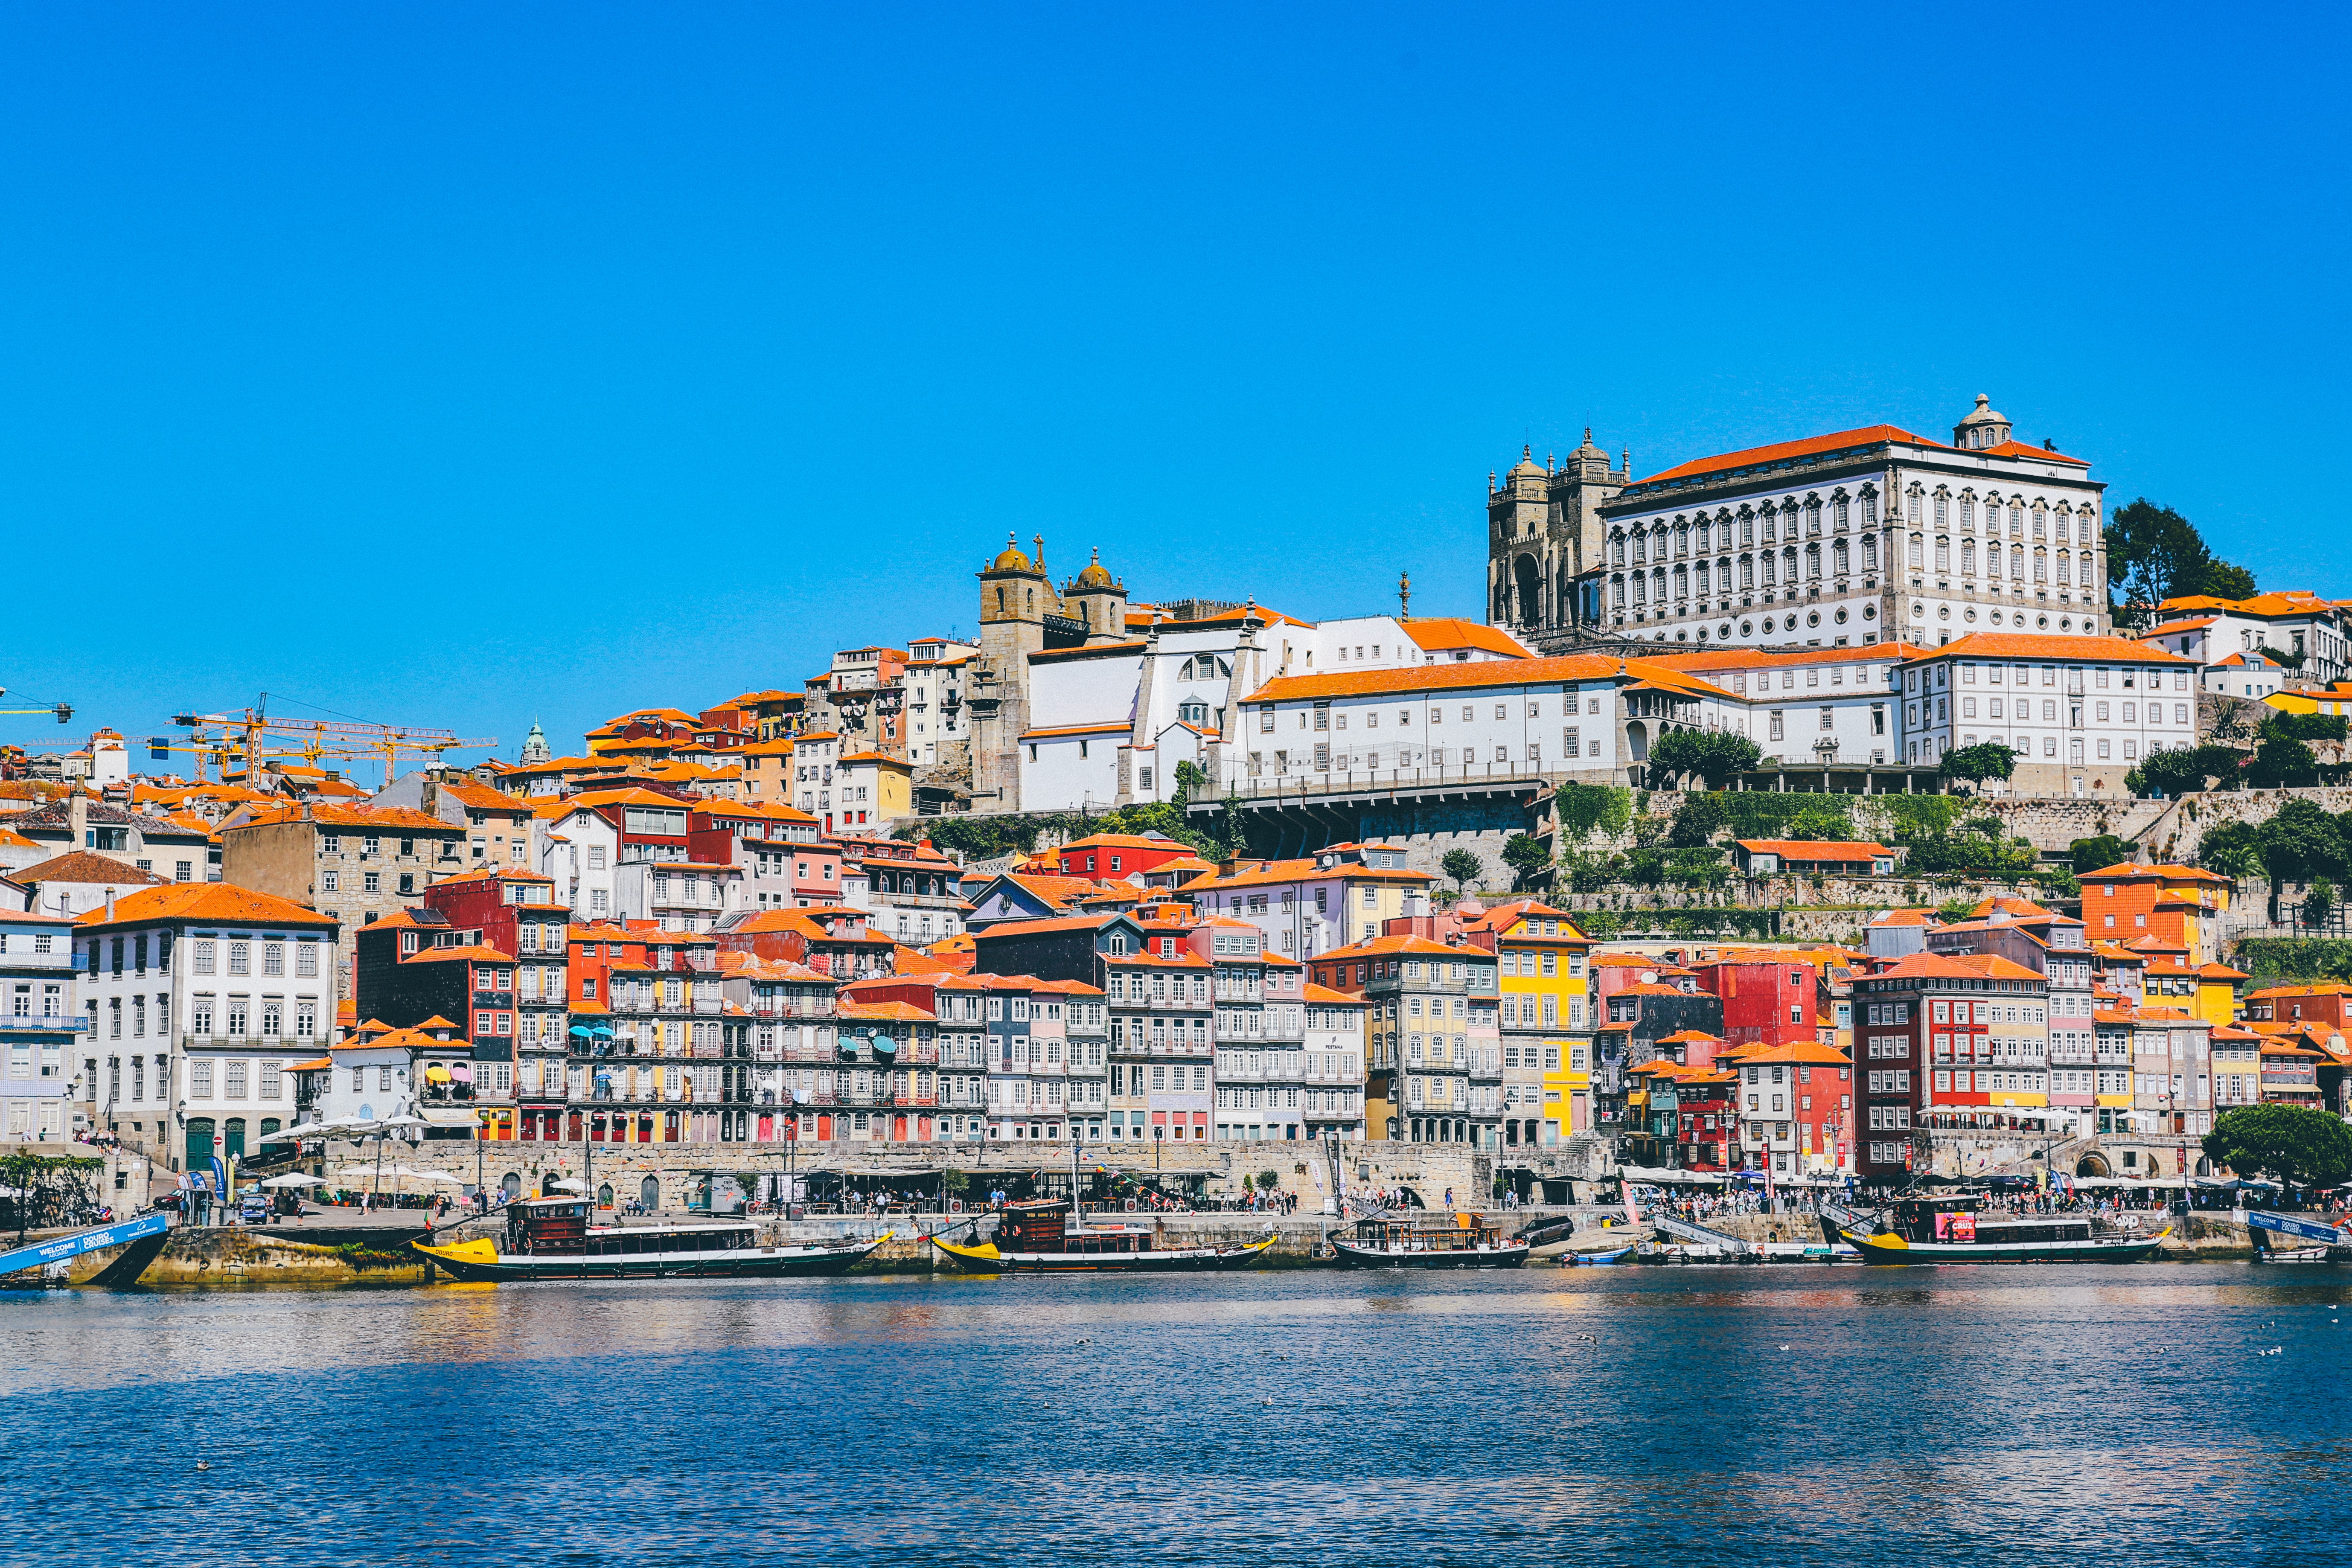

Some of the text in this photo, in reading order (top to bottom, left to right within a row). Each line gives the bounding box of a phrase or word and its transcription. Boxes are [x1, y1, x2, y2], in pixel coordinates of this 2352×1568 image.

[2253, 1215, 2276, 1225] WELCOME
[2282, 1221, 2300, 1229] DOURO
[2281, 1225, 2302, 1234] CRUISES
[83, 1232, 109, 1244] DOURO
[84, 1236, 114, 1249] CRUISES
[39, 1242, 76, 1256] WELCOME
[49, 1250, 69, 1259] ABOARD
